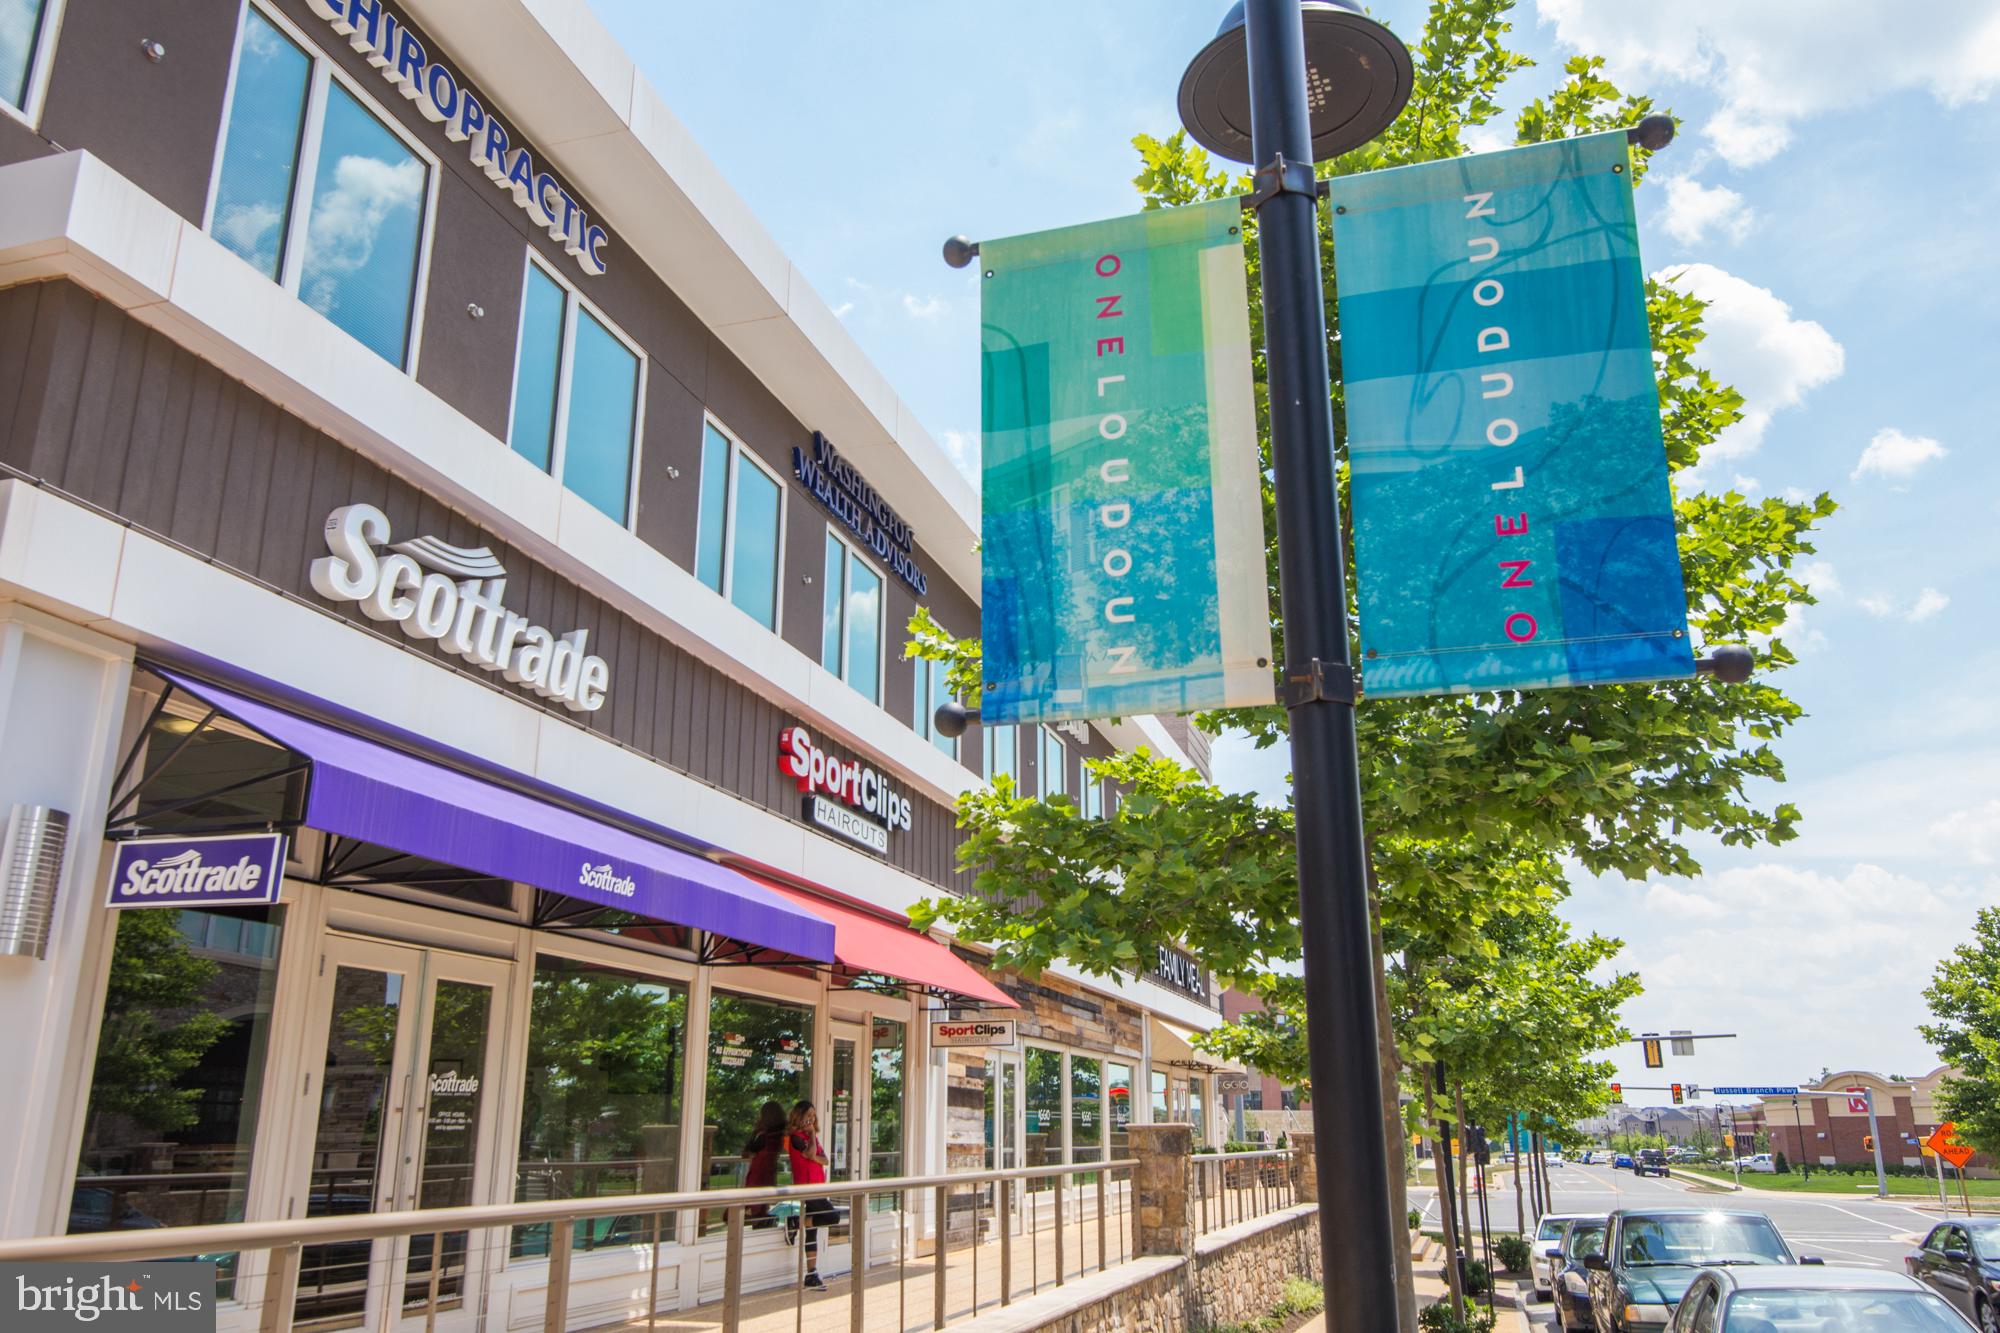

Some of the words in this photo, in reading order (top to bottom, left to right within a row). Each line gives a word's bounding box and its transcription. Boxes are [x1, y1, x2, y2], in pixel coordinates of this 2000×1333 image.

[814, 430, 915, 553] WASHINGTON
[792, 446, 864, 539] WEALTH
[862, 518, 928, 597] ADVISORS
[310, 503, 609, 712] Scottrade
[778, 726, 912, 832] SportClips
[816, 799, 887, 849] HAIRCUTS
[120, 854, 262, 895] Scottrade
[578, 862, 636, 898] Scottrade
[1159, 945, 1186, 988] FAMILY
[939, 1023, 1006, 1037] SportClips
[1714, 1087, 1744, 1095] Russell
[1746, 1087, 1774, 1095] Branch
[1776, 1087, 1798, 1096] Pkwy
